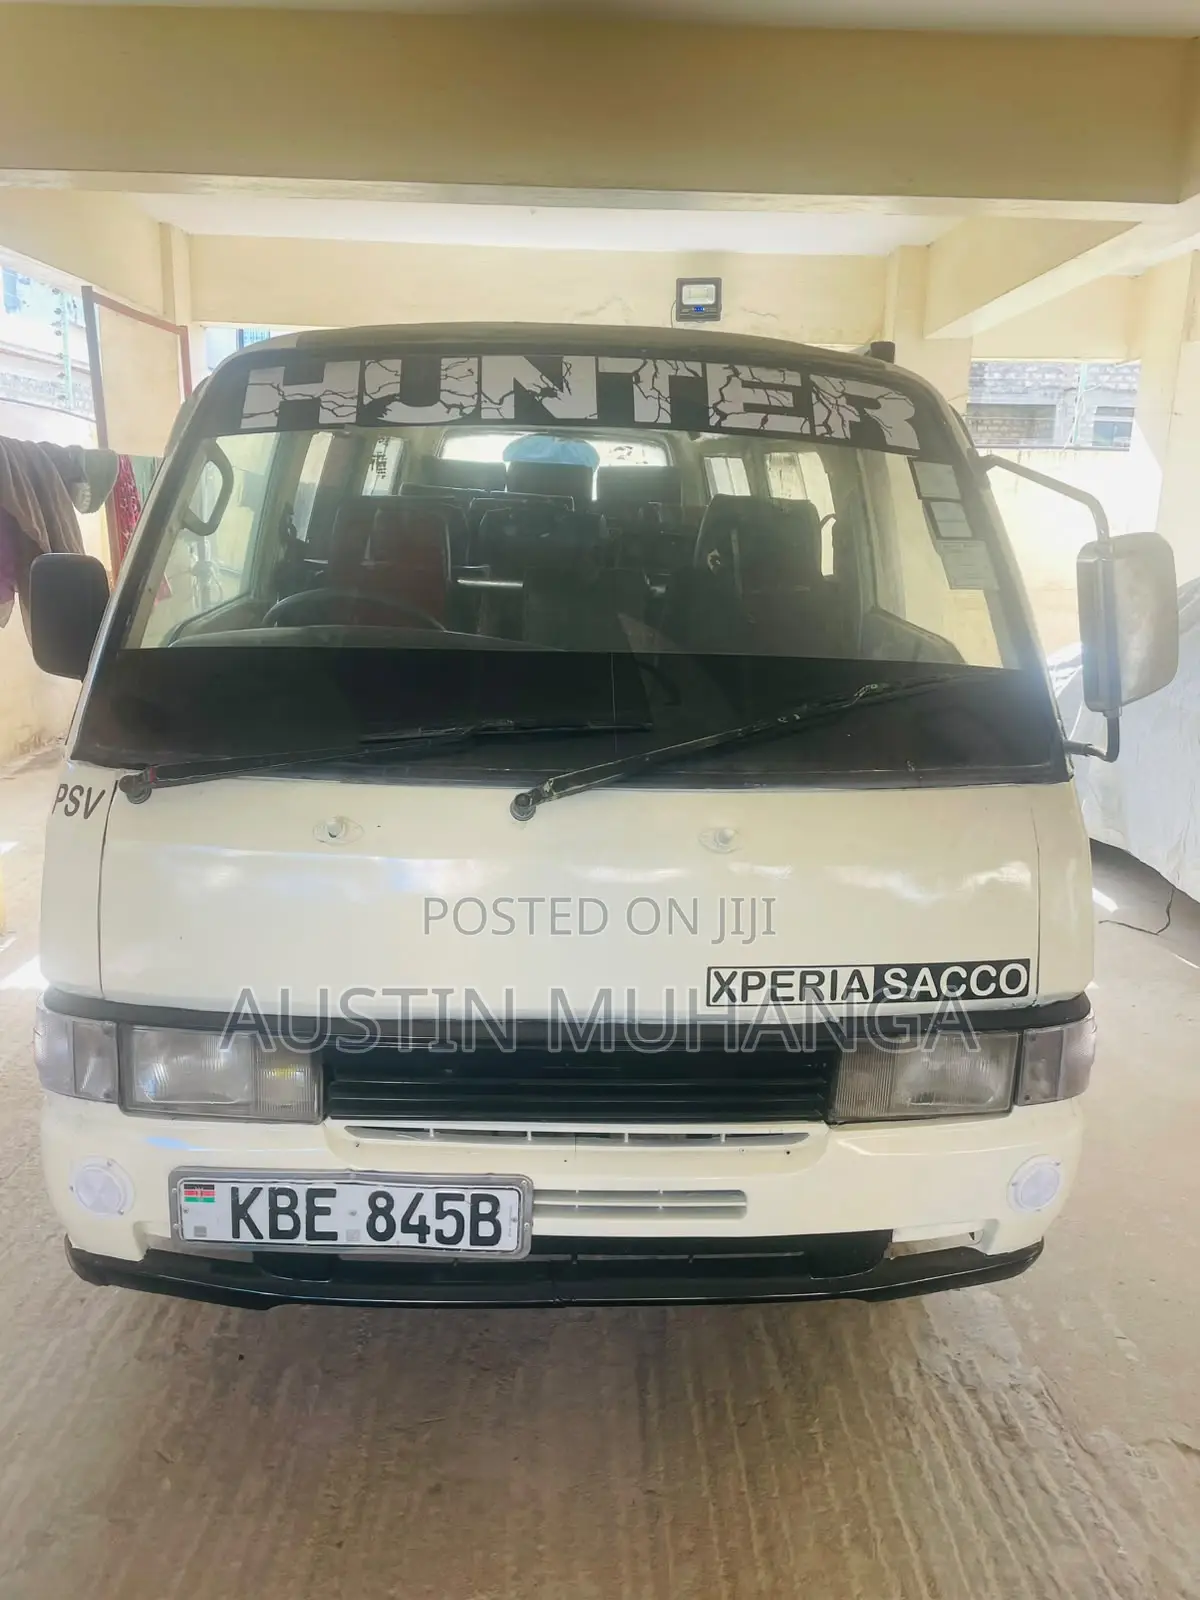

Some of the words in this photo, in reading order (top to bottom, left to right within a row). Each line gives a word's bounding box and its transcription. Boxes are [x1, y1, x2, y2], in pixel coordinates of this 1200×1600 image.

[240, 355, 921, 450] HUNTER
[52, 783, 106, 820] PSV
[711, 968, 870, 1003] XPERIA
[883, 963, 1028, 1000] SACCO
[231, 1186, 339, 1242] KBE
[366, 1190, 502, 1247] 845B
